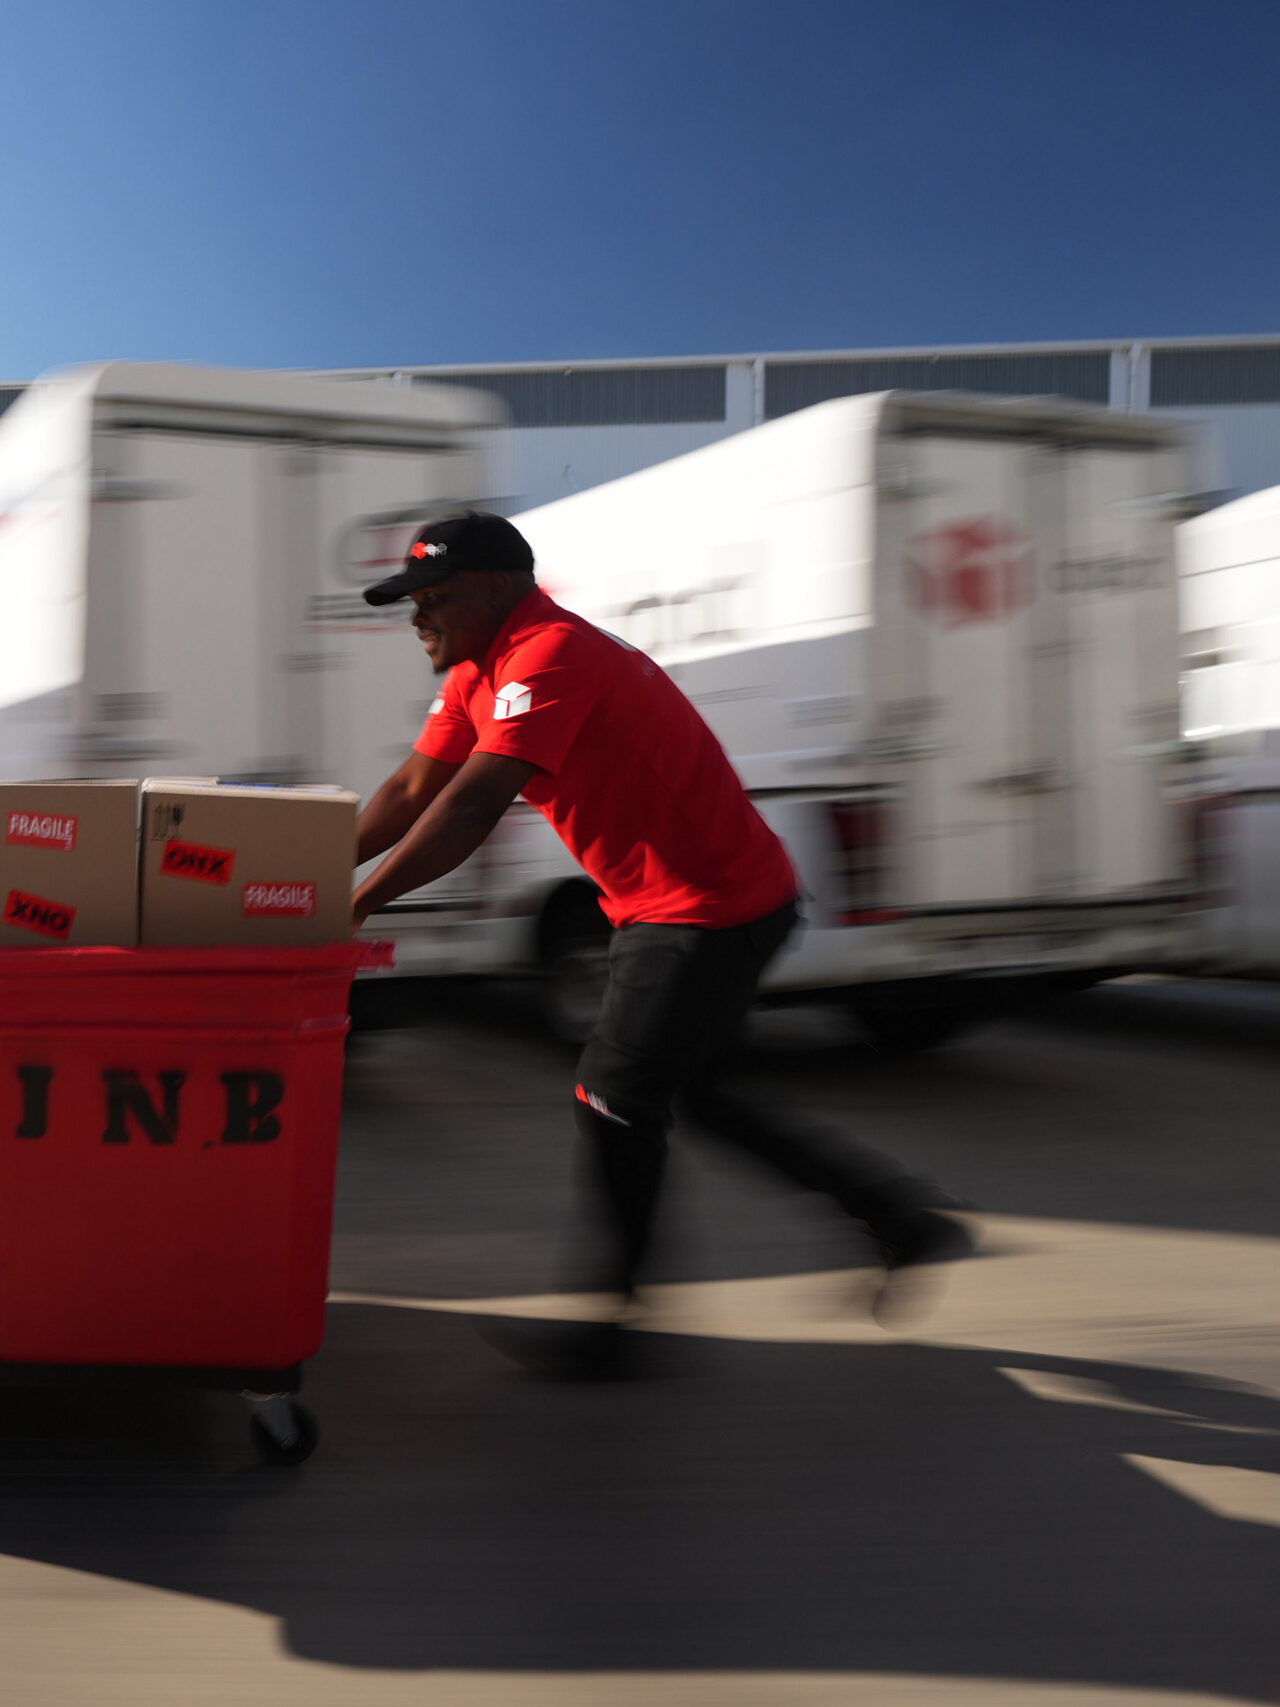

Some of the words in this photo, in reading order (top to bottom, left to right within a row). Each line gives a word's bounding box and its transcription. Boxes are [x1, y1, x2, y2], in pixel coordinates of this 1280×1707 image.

[9, 814, 75, 841] FRAGILE
[167, 848, 229, 880] ONX
[244, 885, 313, 909] FRAGILE
[9, 897, 70, 931] ONX
